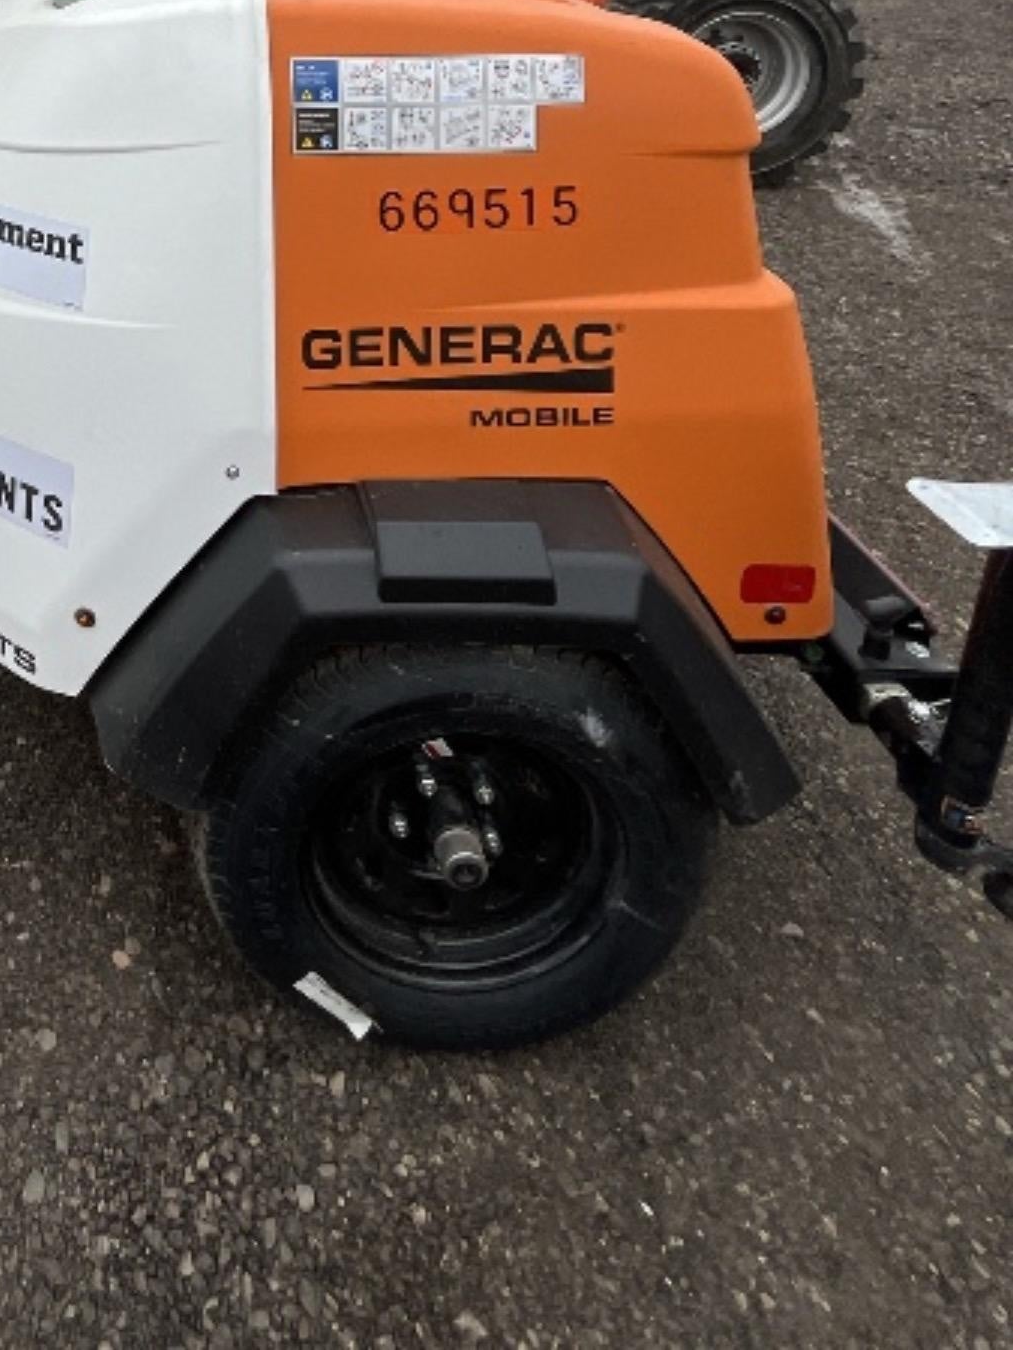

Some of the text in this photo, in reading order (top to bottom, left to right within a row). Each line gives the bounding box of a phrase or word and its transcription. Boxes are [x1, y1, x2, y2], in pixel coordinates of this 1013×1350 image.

[378, 185, 580, 233] 669515
[301, 323, 615, 370] GENERAC
[469, 407, 615, 428] MOBILE
